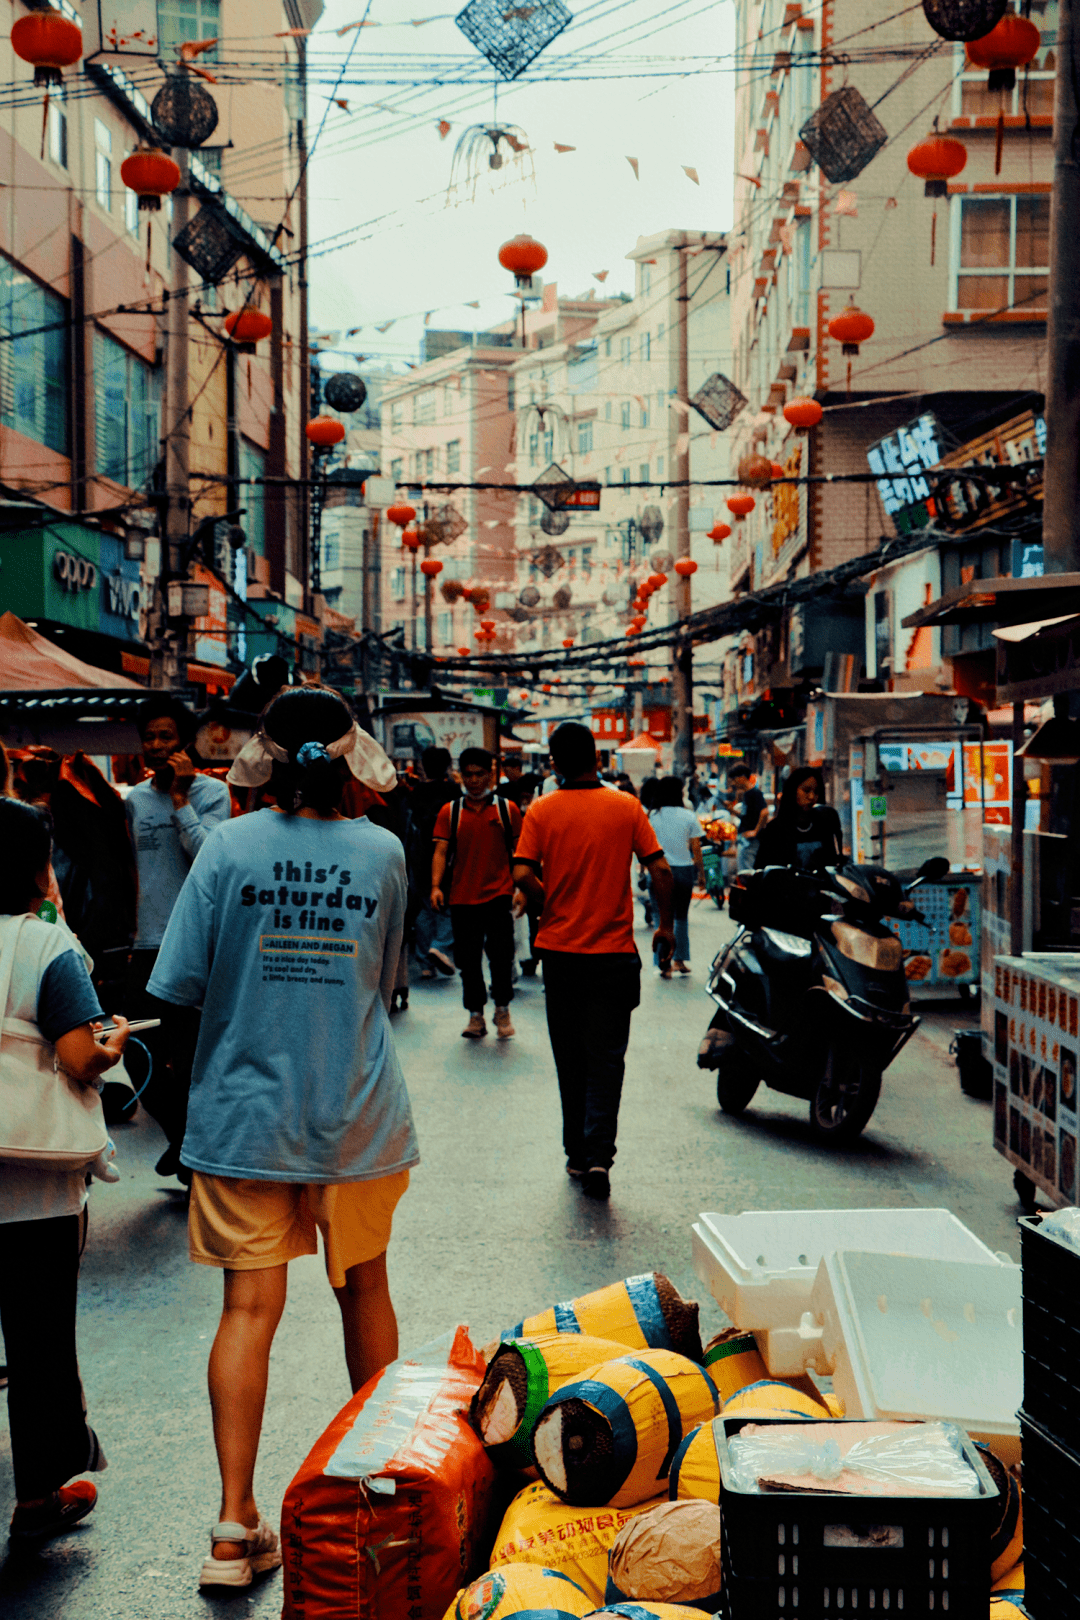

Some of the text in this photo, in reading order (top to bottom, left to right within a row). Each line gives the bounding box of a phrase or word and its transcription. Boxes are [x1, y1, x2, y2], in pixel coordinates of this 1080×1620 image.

[273, 860, 352, 886] this's
[241, 885, 378, 919] Saturday
[274, 909, 345, 932] is fine
[301, 941, 319, 951] AND
[322, 942, 354, 953] MEGAN
[275, 965, 289, 973] cool
[297, 956, 309, 965] day
